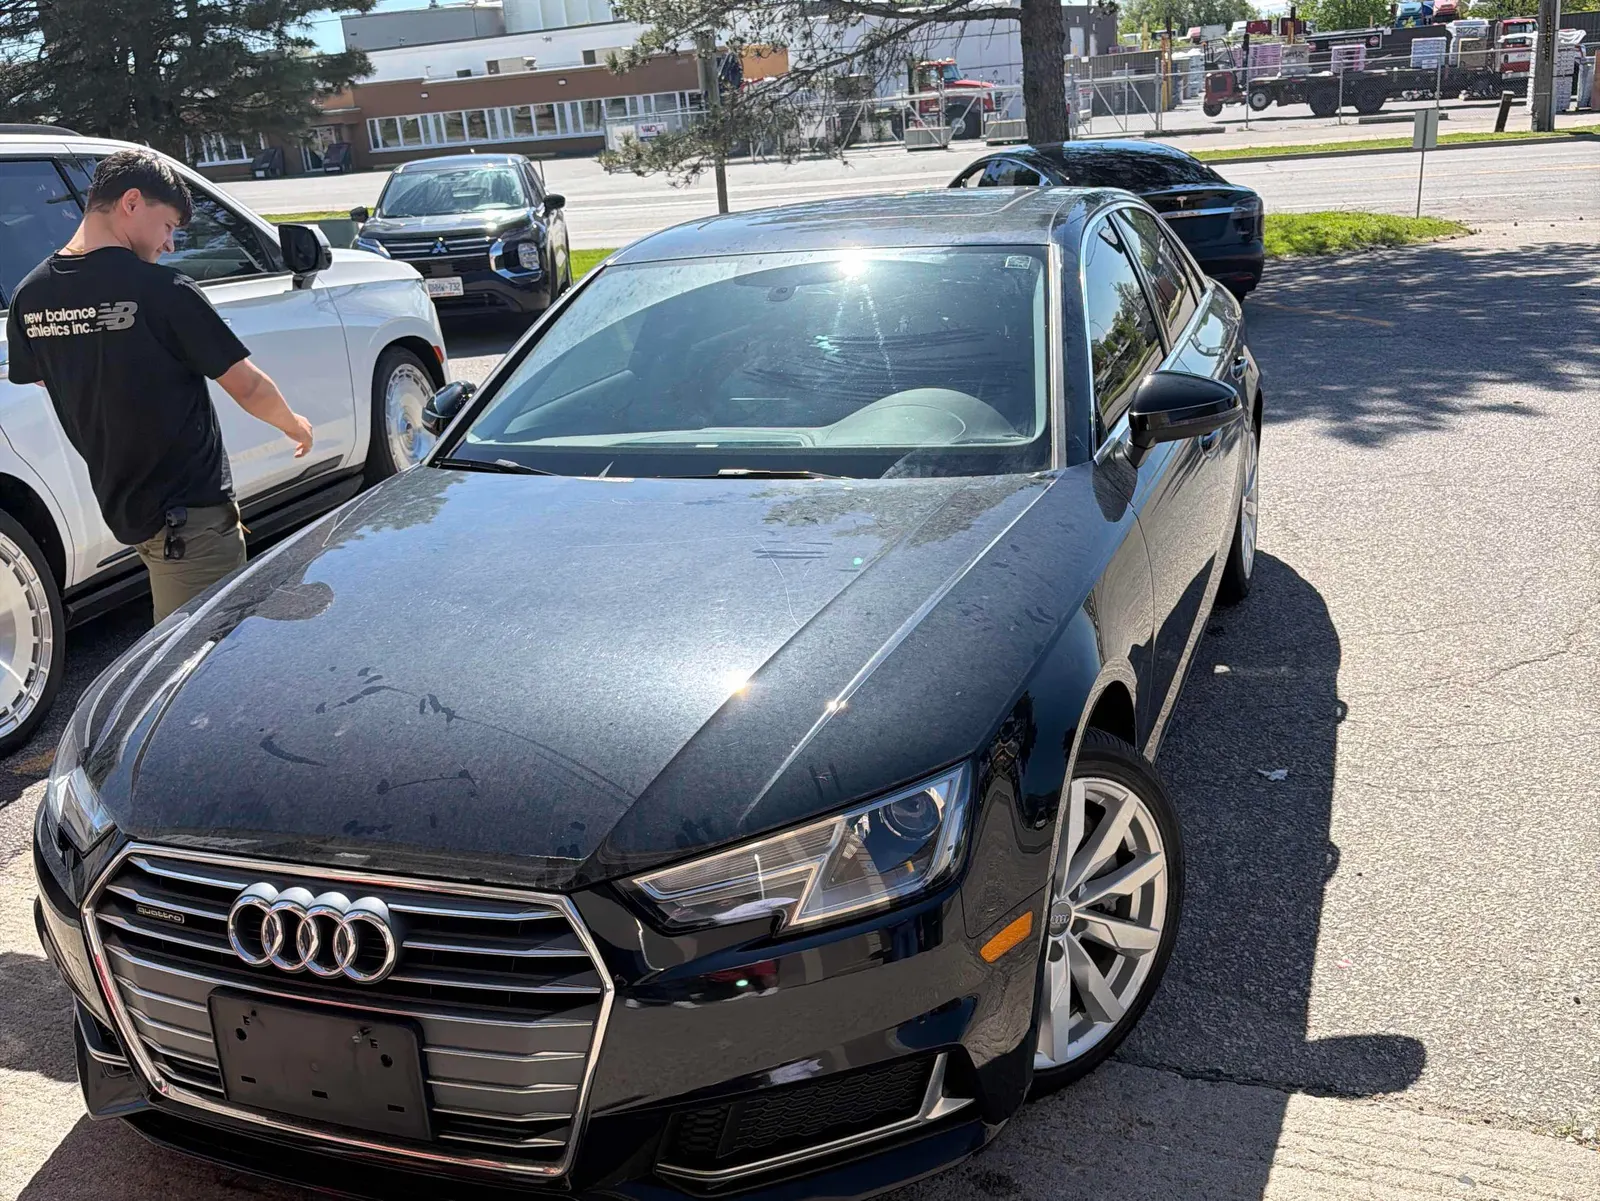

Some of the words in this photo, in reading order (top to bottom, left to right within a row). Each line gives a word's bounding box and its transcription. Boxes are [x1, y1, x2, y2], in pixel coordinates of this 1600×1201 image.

[24, 311, 42, 324] new
[45, 307, 96, 322] balance
[26, 321, 70, 338] athletics
[72, 322, 94, 335] inc.
[137, 906, 181, 921] quattro
